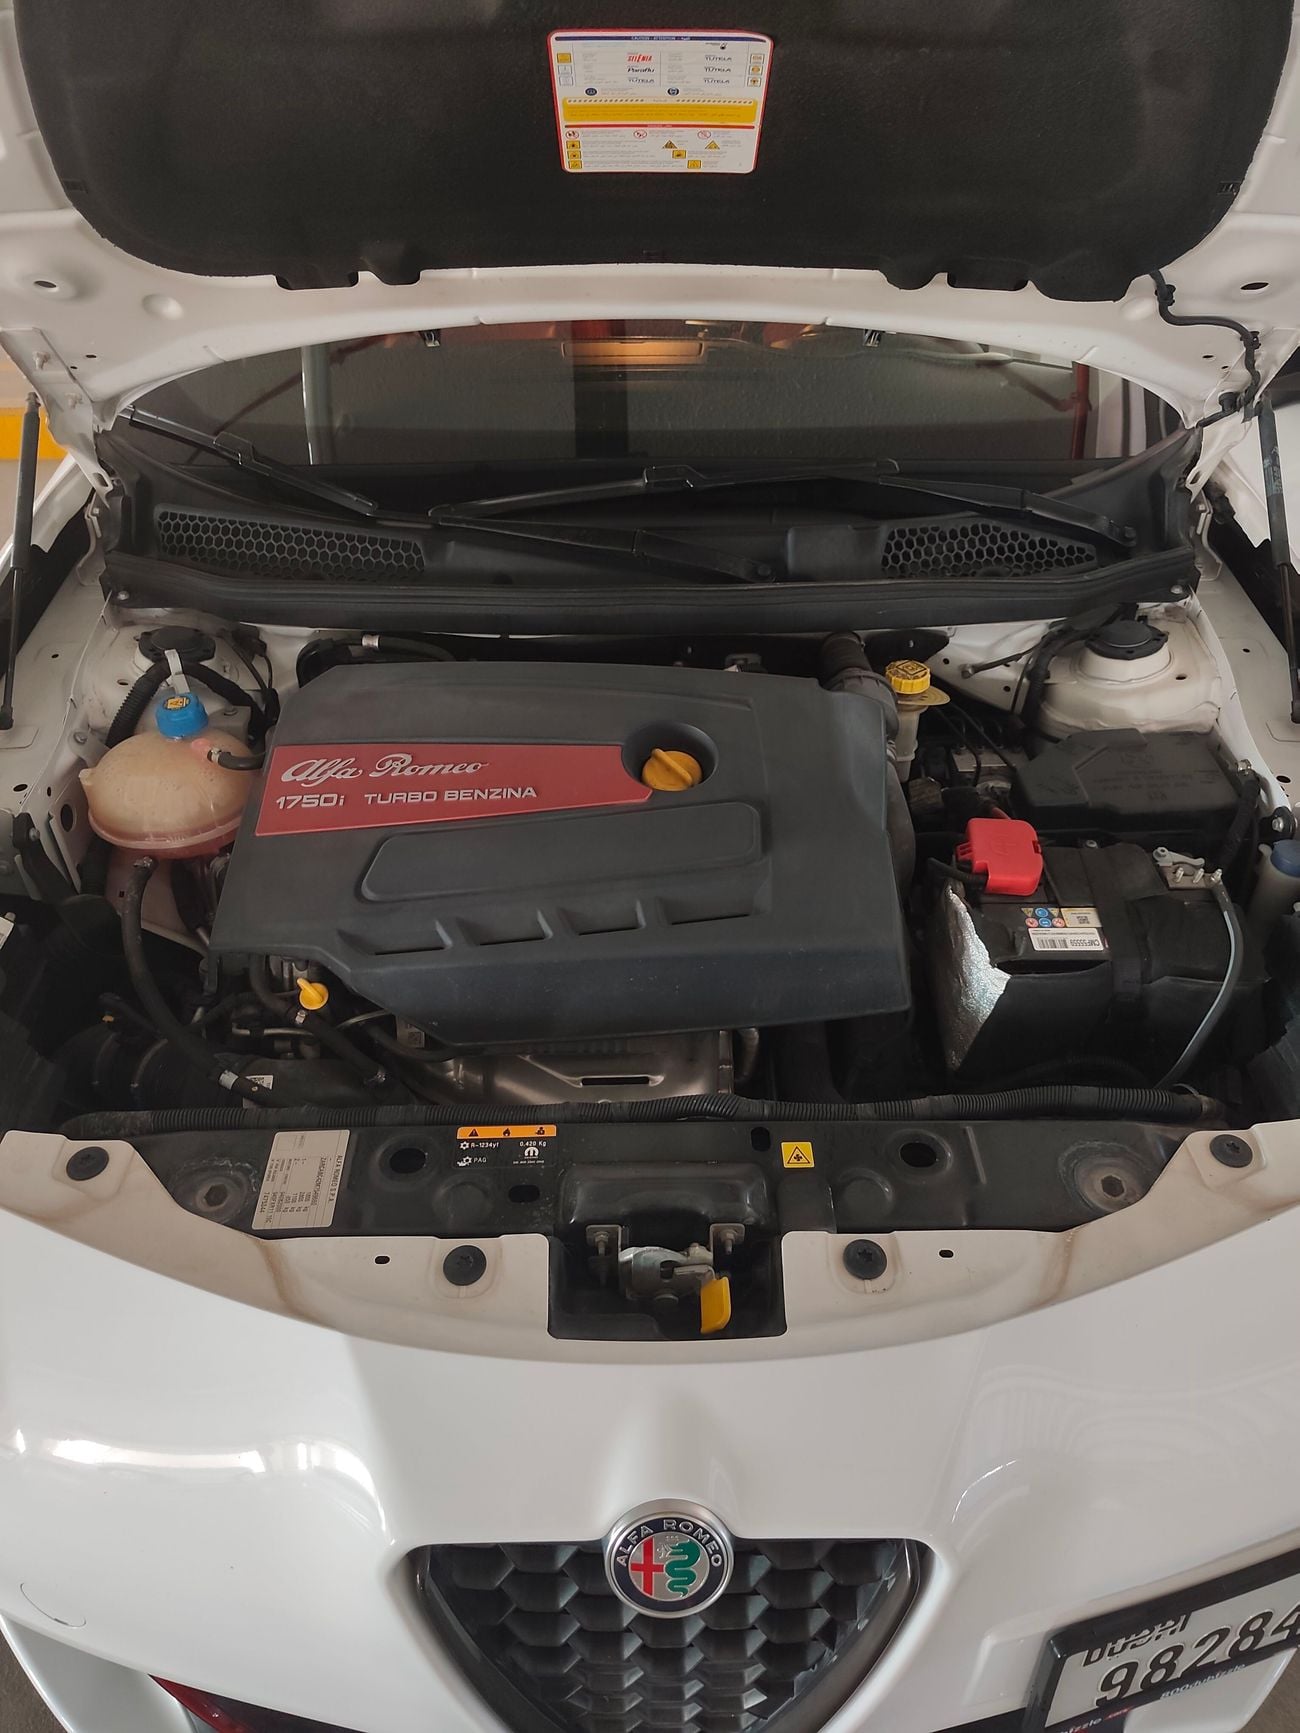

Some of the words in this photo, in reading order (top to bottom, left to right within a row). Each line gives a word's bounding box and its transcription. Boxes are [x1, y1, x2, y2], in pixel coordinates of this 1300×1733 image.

[281, 758, 363, 788] Alfa
[369, 753, 489, 778] Romeo
[276, 793, 344, 810] 1750i
[364, 790, 438, 805] TURBO
[443, 786, 538, 802] BENZINA
[616, 1525, 654, 1567] ALFA
[663, 1519, 723, 1567] ROMEO
[1095, 1604, 1300, 1707] 98284
